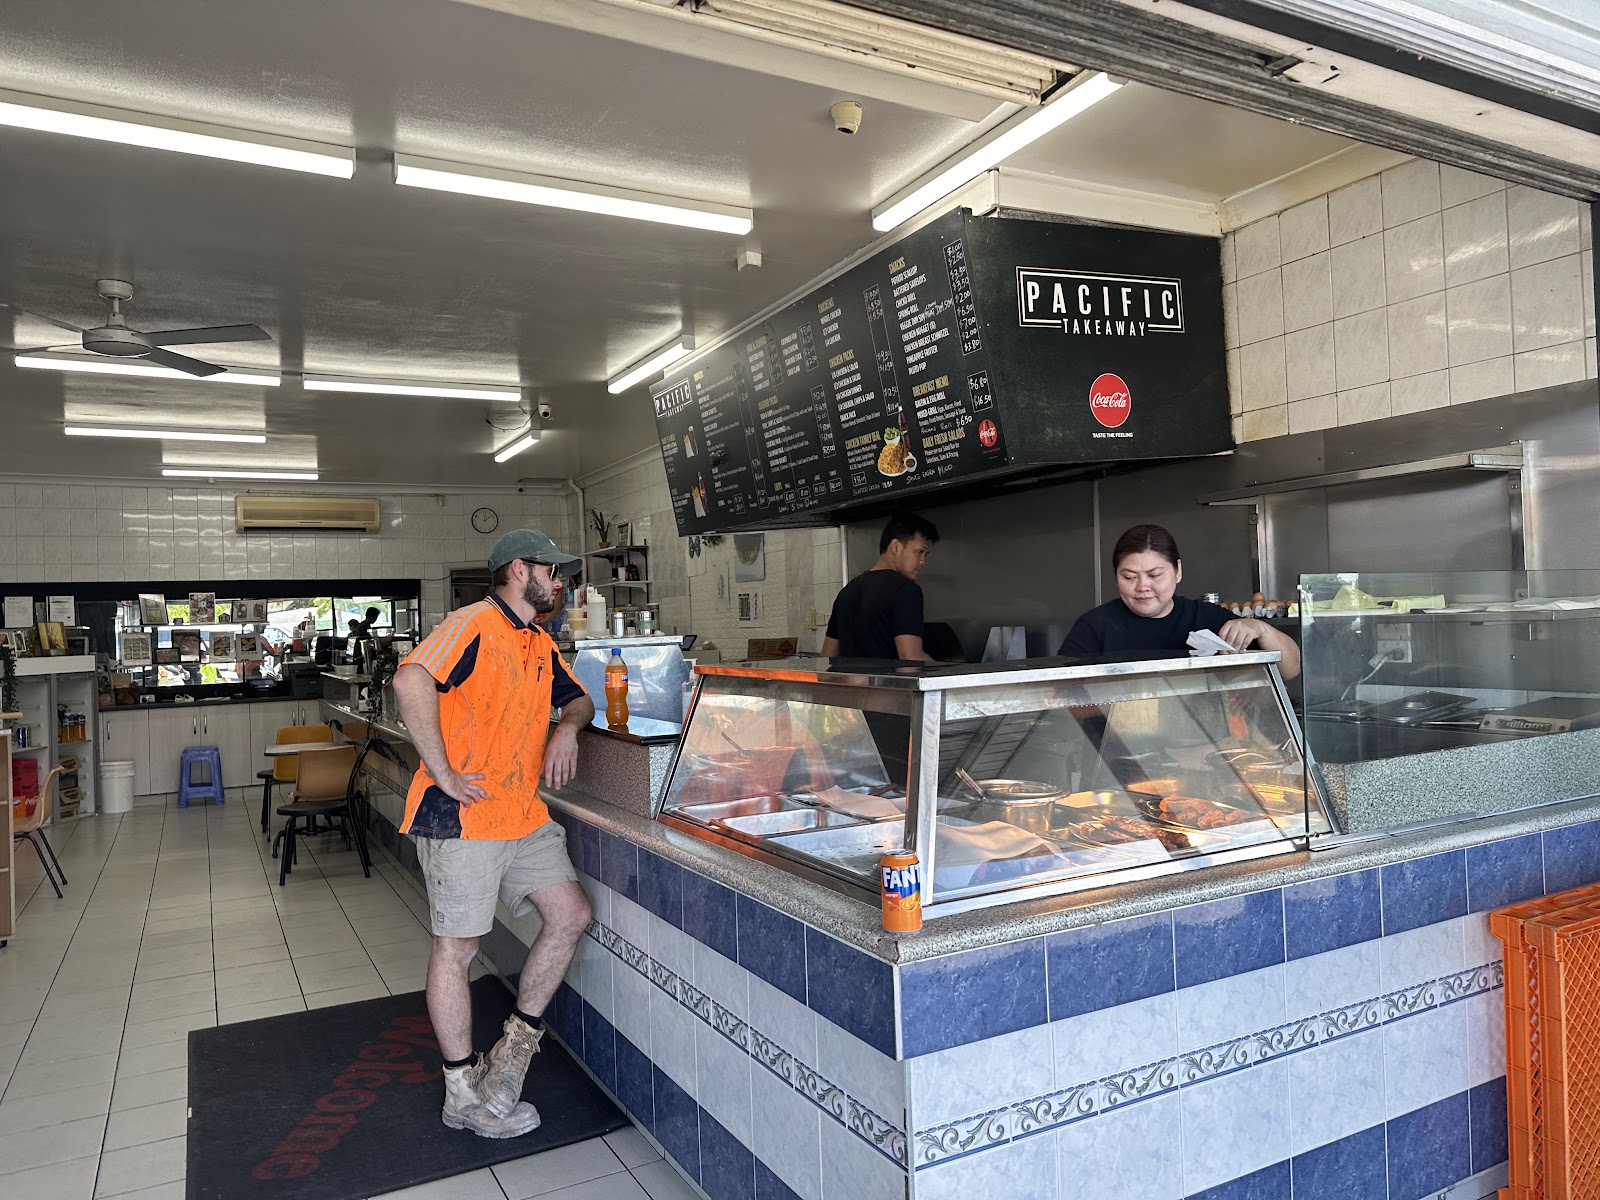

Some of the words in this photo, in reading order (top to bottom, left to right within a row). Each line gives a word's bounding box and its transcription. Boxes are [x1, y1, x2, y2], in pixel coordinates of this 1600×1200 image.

[1026, 281, 1175, 319] PACIFIC
[1063, 318, 1145, 337] TAKEAWAY
[655, 386, 691, 414] PACIFIC
